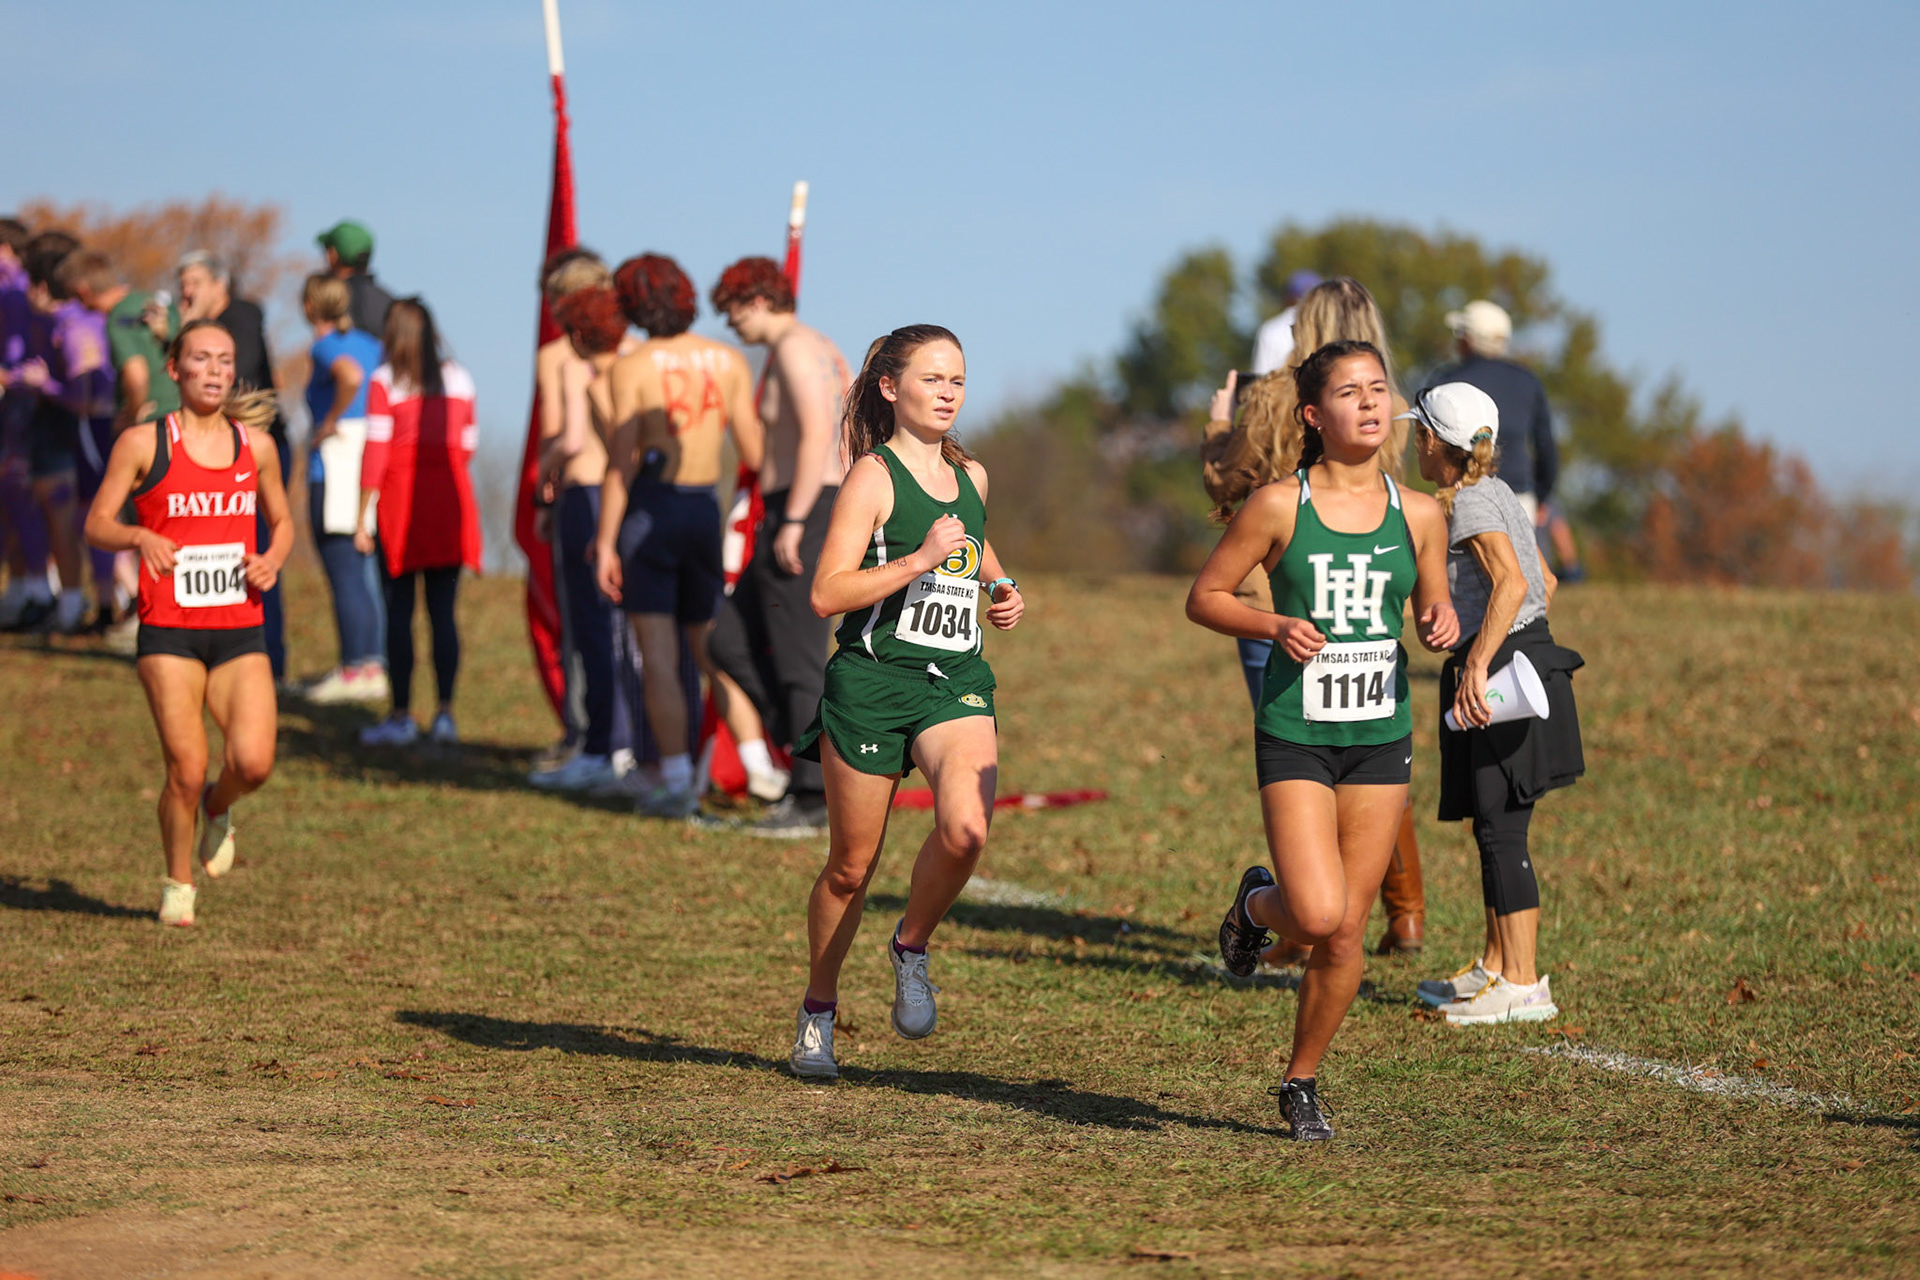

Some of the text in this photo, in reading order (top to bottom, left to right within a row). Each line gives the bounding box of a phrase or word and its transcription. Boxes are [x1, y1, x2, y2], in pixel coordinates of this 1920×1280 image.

[182, 566, 242, 595] 1004
[920, 581, 946, 595] TMSAA
[946, 586, 965, 598] STATE
[909, 600, 972, 641] 1034
[1316, 652, 1350, 664] TMSAA
[1352, 651, 1378, 664] STATE
[1317, 671, 1384, 709] 1114
